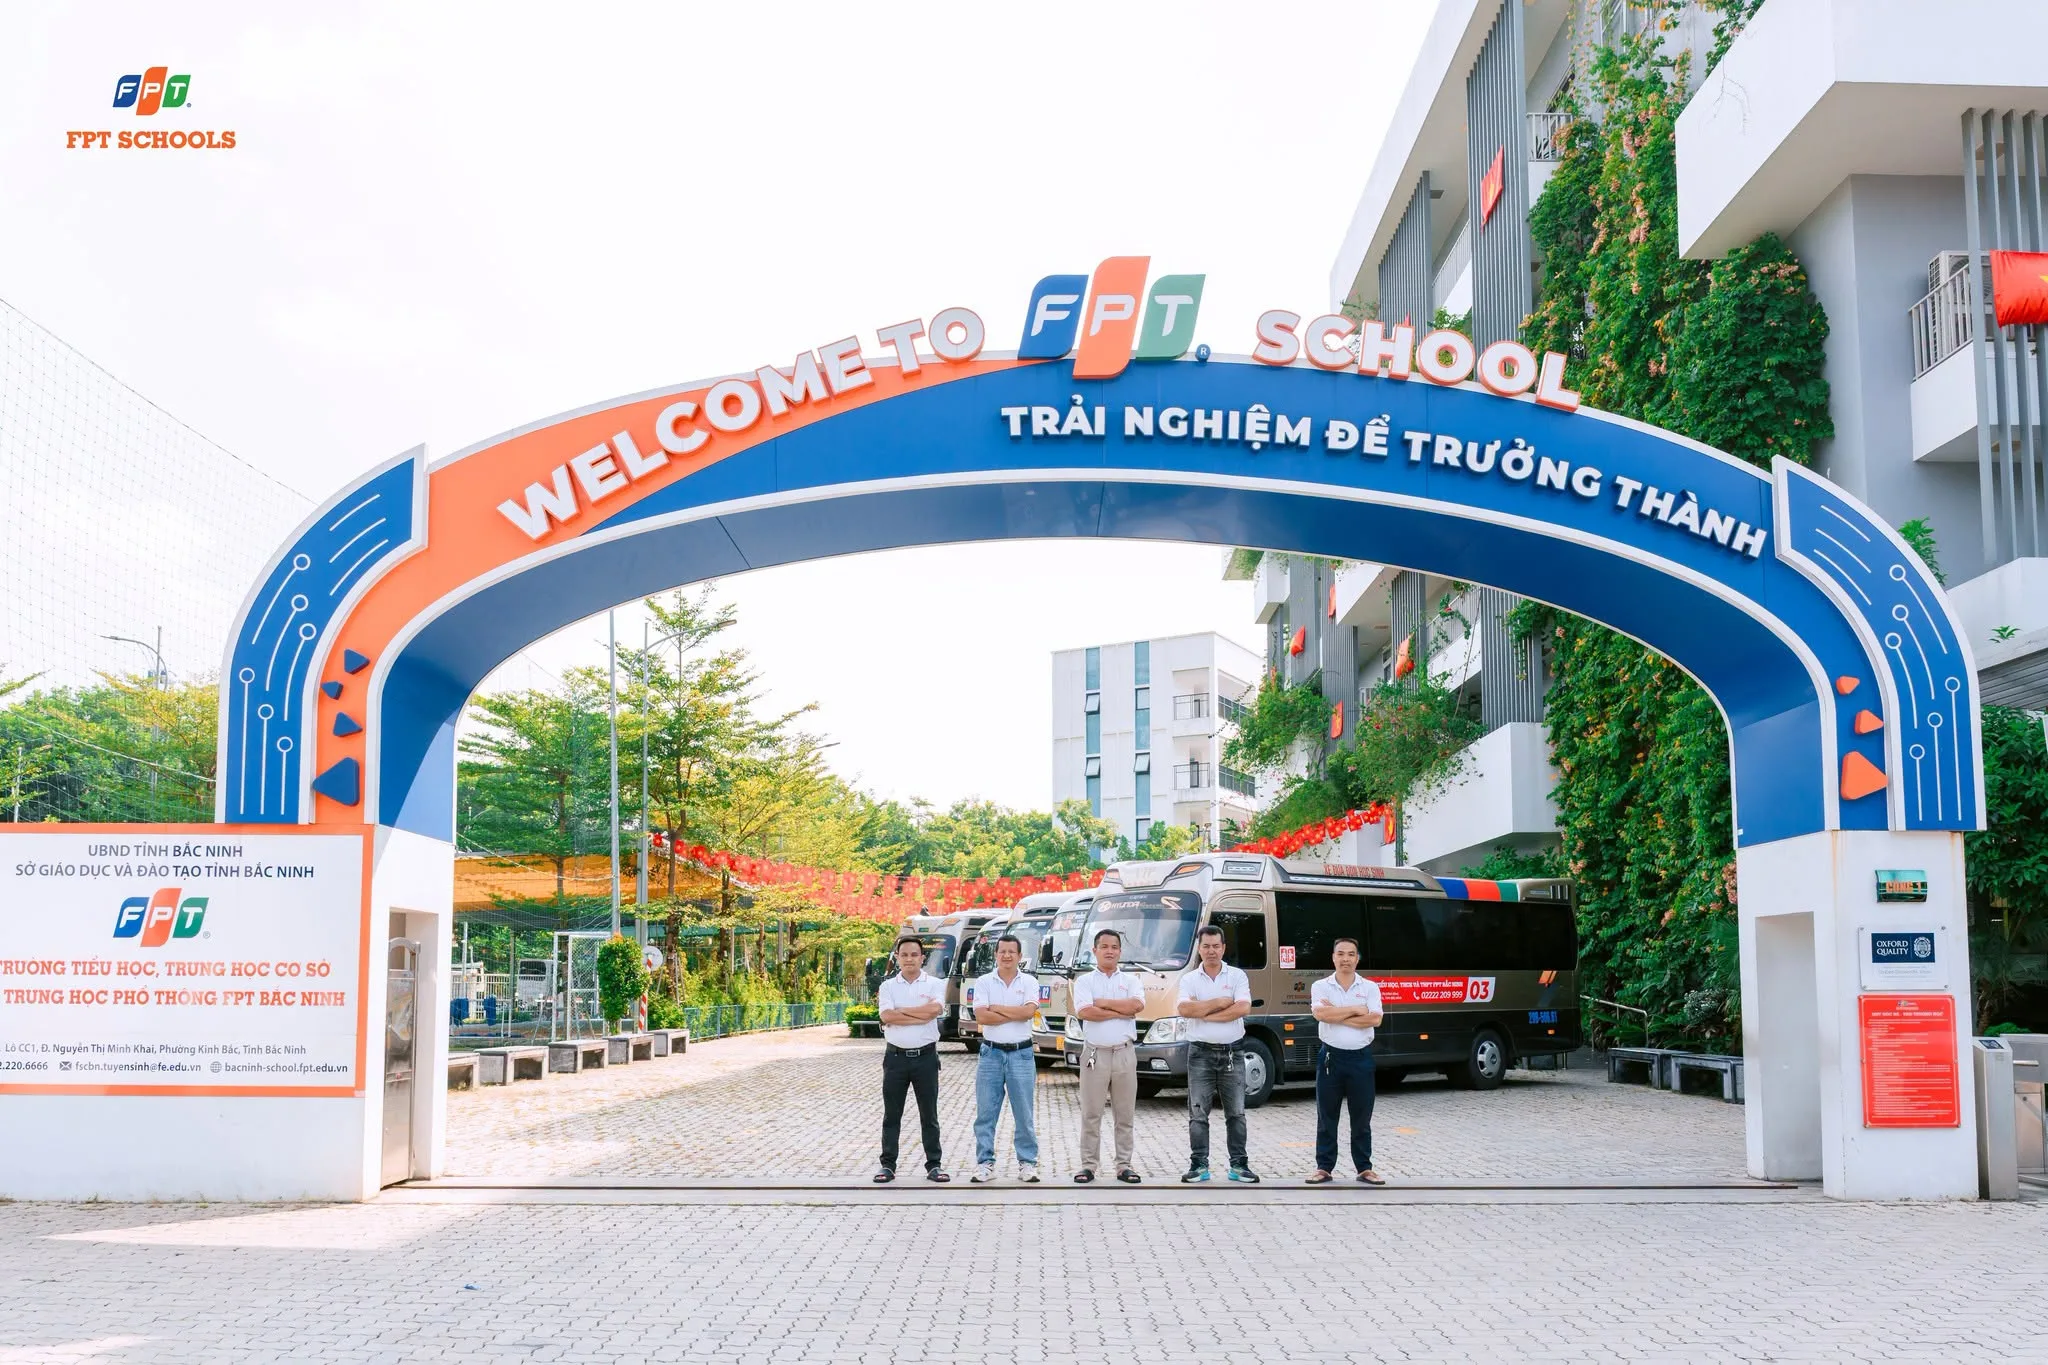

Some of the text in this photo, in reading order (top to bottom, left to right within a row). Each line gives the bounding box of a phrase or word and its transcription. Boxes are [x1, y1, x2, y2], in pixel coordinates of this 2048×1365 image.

[1252, 308, 1582, 413] SCHOOL
[496, 306, 986, 542] WELCOME TO
[1001, 394, 1767, 560] TRẢI NGHIỆM ĐỂ TRƯỞNG THÀNH
[88, 841, 243, 858] UBND TỈNH BẮC NINH
[15, 860, 314, 881] SỞ GIÁO DỤC VÀ ĐÀO TẠO TỈNH BẮC NINH
[1876, 940, 1909, 948] OXFORD
[1876, 947, 1909, 957] QUALITY
[116, 961, 159, 980] HỌC,
[165, 961, 226, 977] TRUNG
[230, 961, 270, 980] HỌC
[4, 985, 345, 1008] TRUNG HỌC PHỔ THÔNG FPT BẮC NINH
[1421, 991, 1439, 1000] 02222
[1470, 980, 1490, 1001] 03
[18, 1043, 39, 1055] CC1,
[41, 1043, 51, 1054] Đ.
[91, 1043, 105, 1056] Thị
[107, 1044, 131, 1054] Minh
[133, 1044, 157, 1055] Khai,
[159, 1043, 196, 1057] Phường
[198, 1044, 219, 1055] Kinh
[265, 1044, 282, 1055] Bắc
[284, 1044, 307, 1055] Ninh
[75, 1060, 201, 1074] fscbn.tuyensinh@fe.edu.vn
[225, 1062, 348, 1076] bacninh-school.fpt.edu.vn
